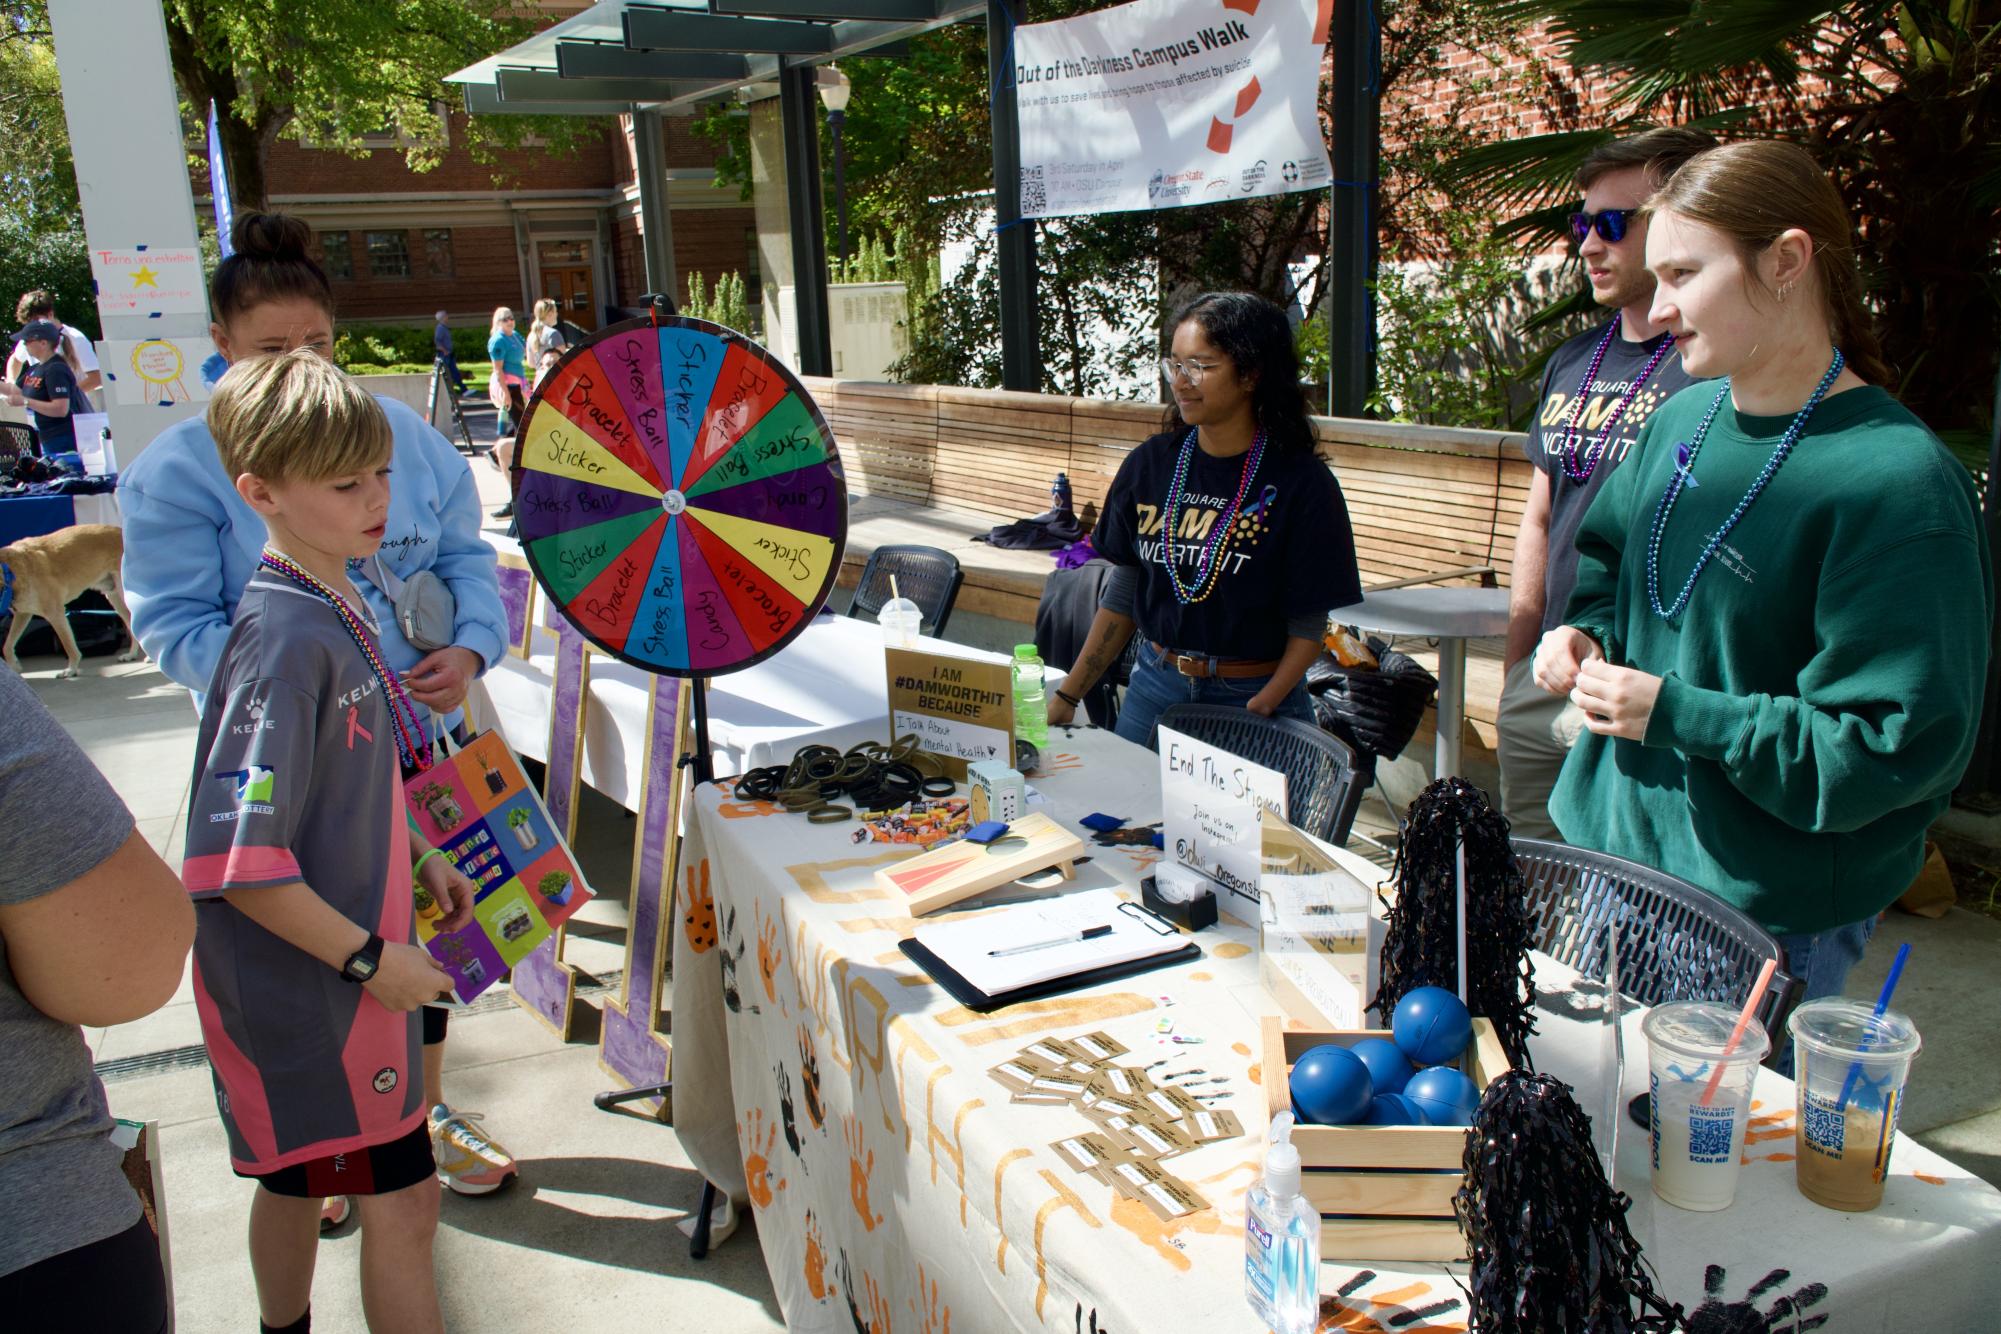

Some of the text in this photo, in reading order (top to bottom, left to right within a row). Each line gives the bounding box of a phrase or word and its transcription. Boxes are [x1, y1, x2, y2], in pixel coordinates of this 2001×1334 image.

[1017, 20, 1250, 85] Out of the Darkness Campus Walk
[1176, 68, 1210, 86] affected
[1211, 65, 1222, 77] by
[567, 373, 631, 448] Bracelet
[615, 339, 664, 449] Stress Ball
[711, 366, 768, 440] Bracelet
[547, 429, 608, 475] Sticker
[716, 425, 810, 483] Stress Ball
[1609, 438, 1637, 462] IT
[525, 490, 611, 516] Stress Ball
[559, 540, 608, 579] Sticker
[753, 537, 811, 581] Sticker
[1220, 551, 1251, 575] IT
[585, 558, 639, 626] Bracelet
[643, 566, 675, 657] Stress Ball
[724, 560, 791, 634] Bracelet
[695, 591, 729, 650] Candy
[895, 676, 1005, 706] #DAMWORTHIT
[933, 666, 962, 683] I AM
[897, 716, 905, 729] I
[918, 695, 982, 718] BECAUSE
[1170, 743, 1195, 777] End
[1202, 756, 1225, 790] The
[1193, 804, 1234, 831] Join us on
[1689, 1109, 1735, 1117] REWARDS?
[1689, 1155, 1713, 1164] SCAN
